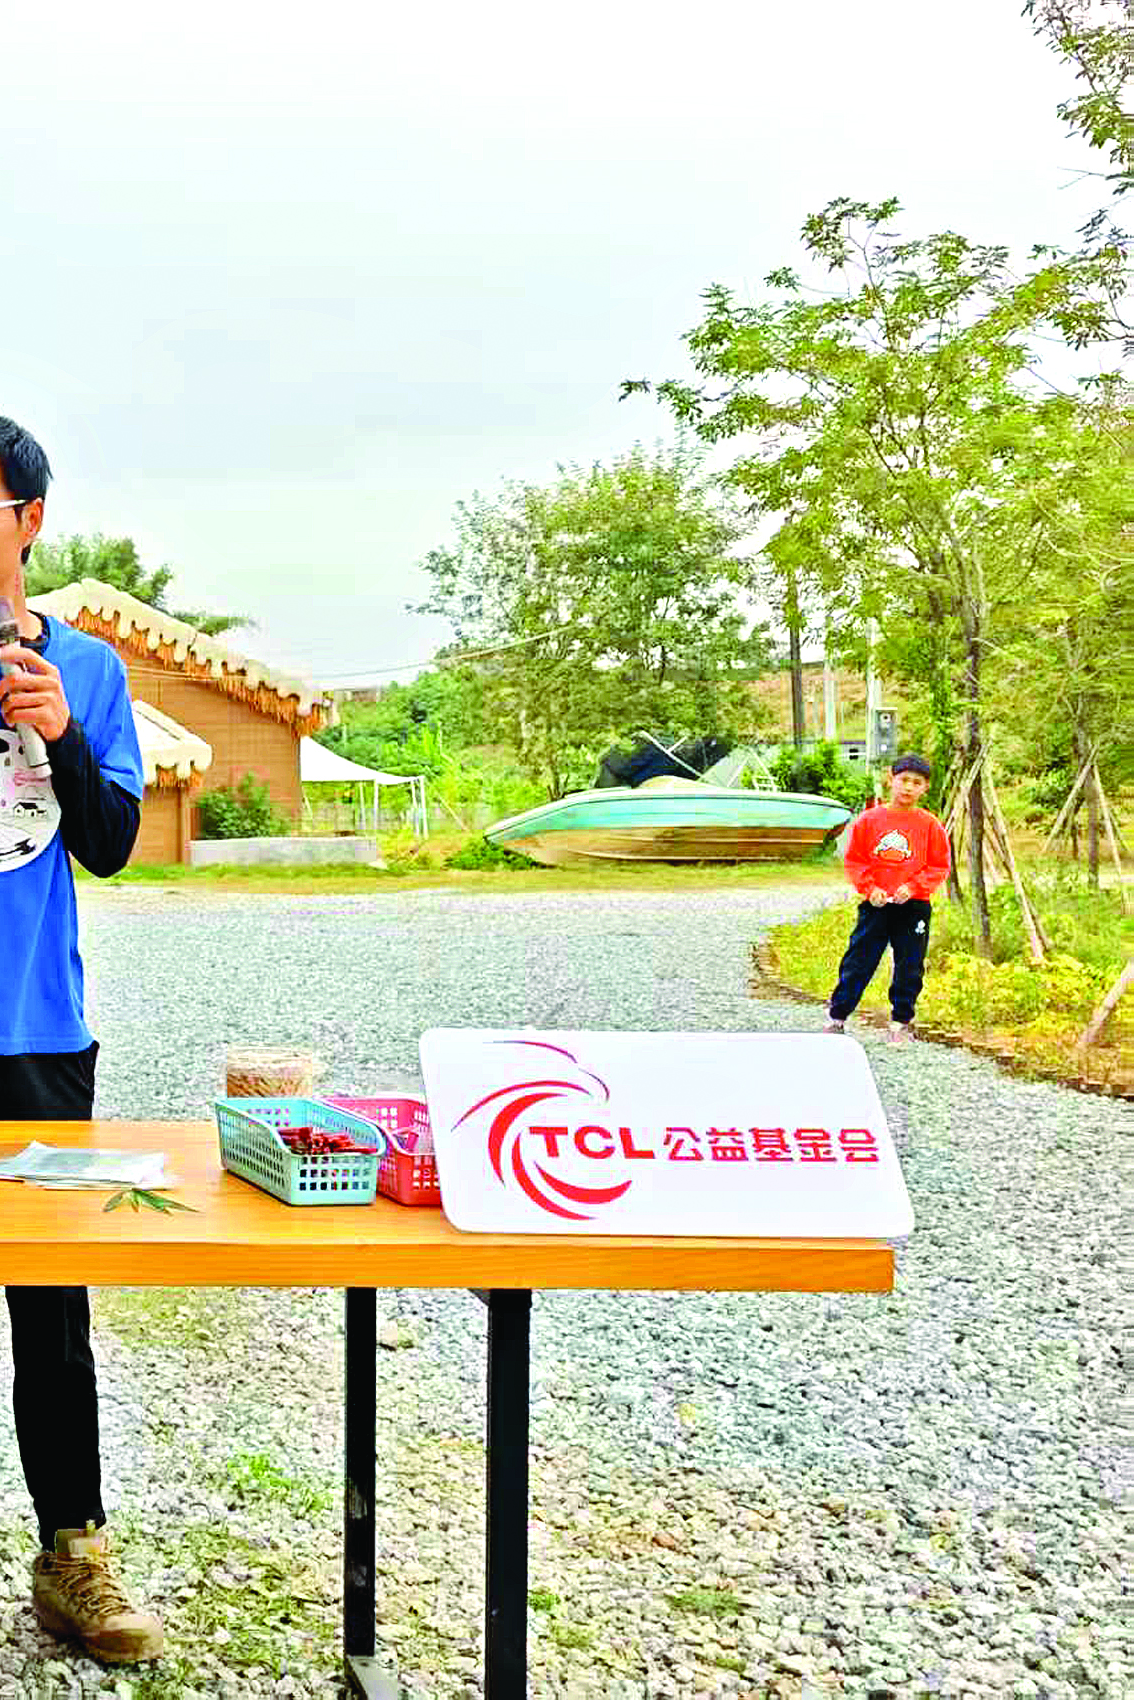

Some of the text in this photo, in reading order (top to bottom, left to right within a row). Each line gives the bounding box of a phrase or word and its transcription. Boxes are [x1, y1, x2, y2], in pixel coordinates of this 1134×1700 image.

[528, 1125, 879, 1163] TCL 公益基金会
